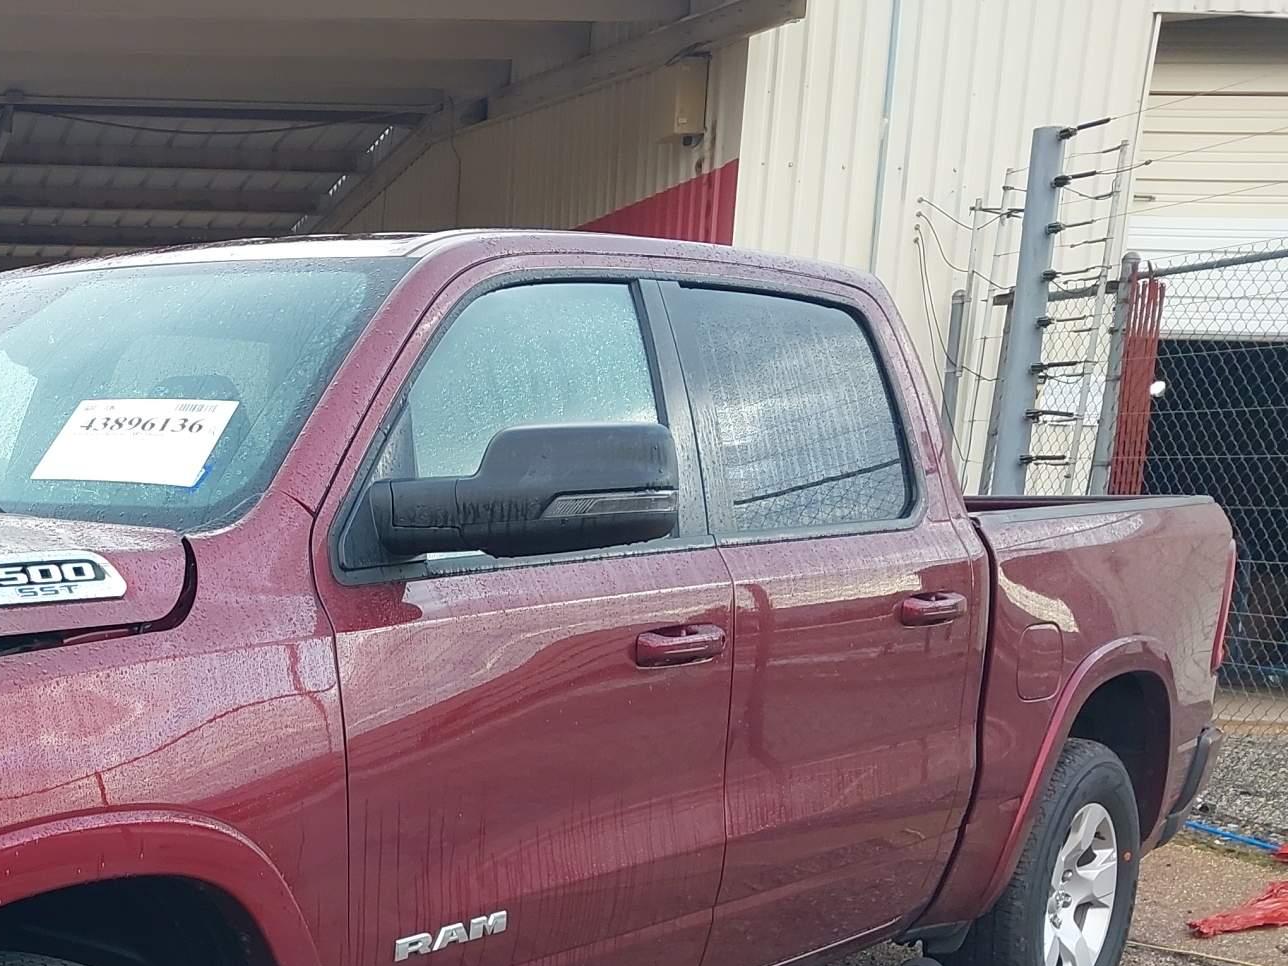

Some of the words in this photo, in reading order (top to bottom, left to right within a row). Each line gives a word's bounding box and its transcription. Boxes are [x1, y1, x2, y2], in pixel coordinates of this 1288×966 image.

[80, 416, 204, 433] 43896136
[16, 584, 78, 598] SST
[394, 910, 508, 962] RAM
